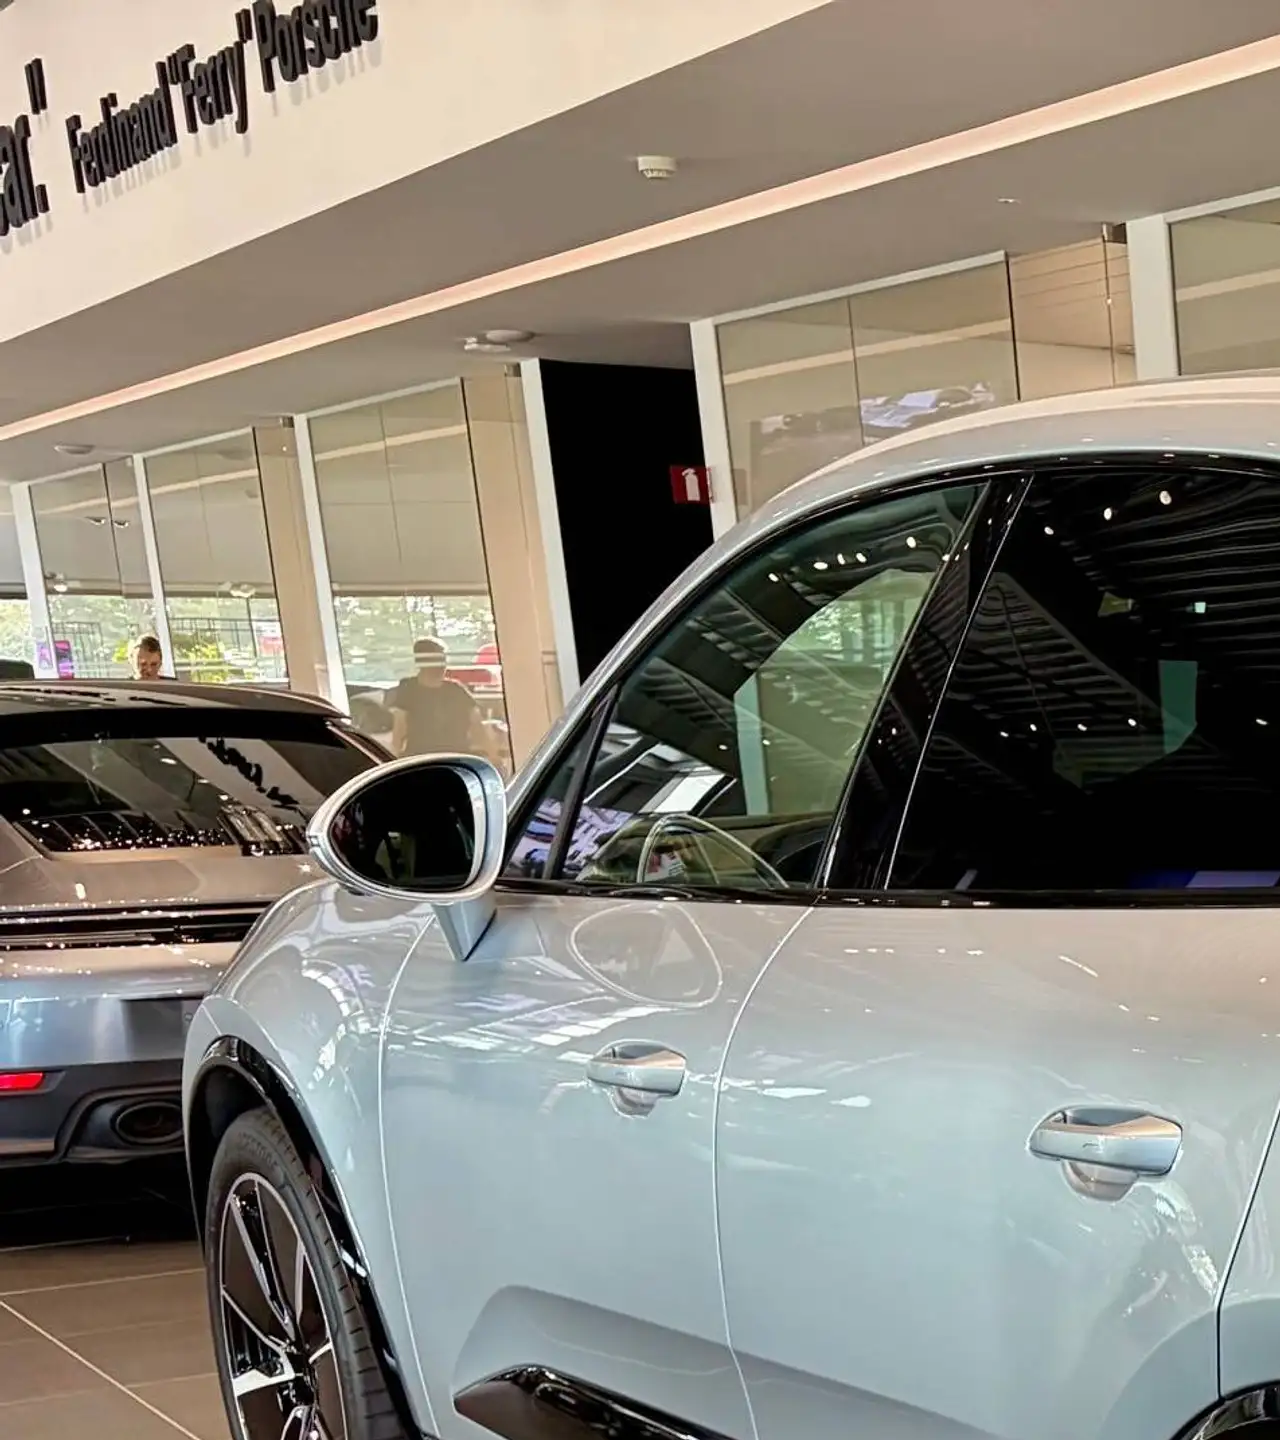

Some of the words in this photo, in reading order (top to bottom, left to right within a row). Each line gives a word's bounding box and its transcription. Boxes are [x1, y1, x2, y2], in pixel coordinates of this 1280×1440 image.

[65, 61, 179, 194] Ferdinand
[166, 8, 254, 135] "Ferry"
[253, 0, 379, 94] Porsche
